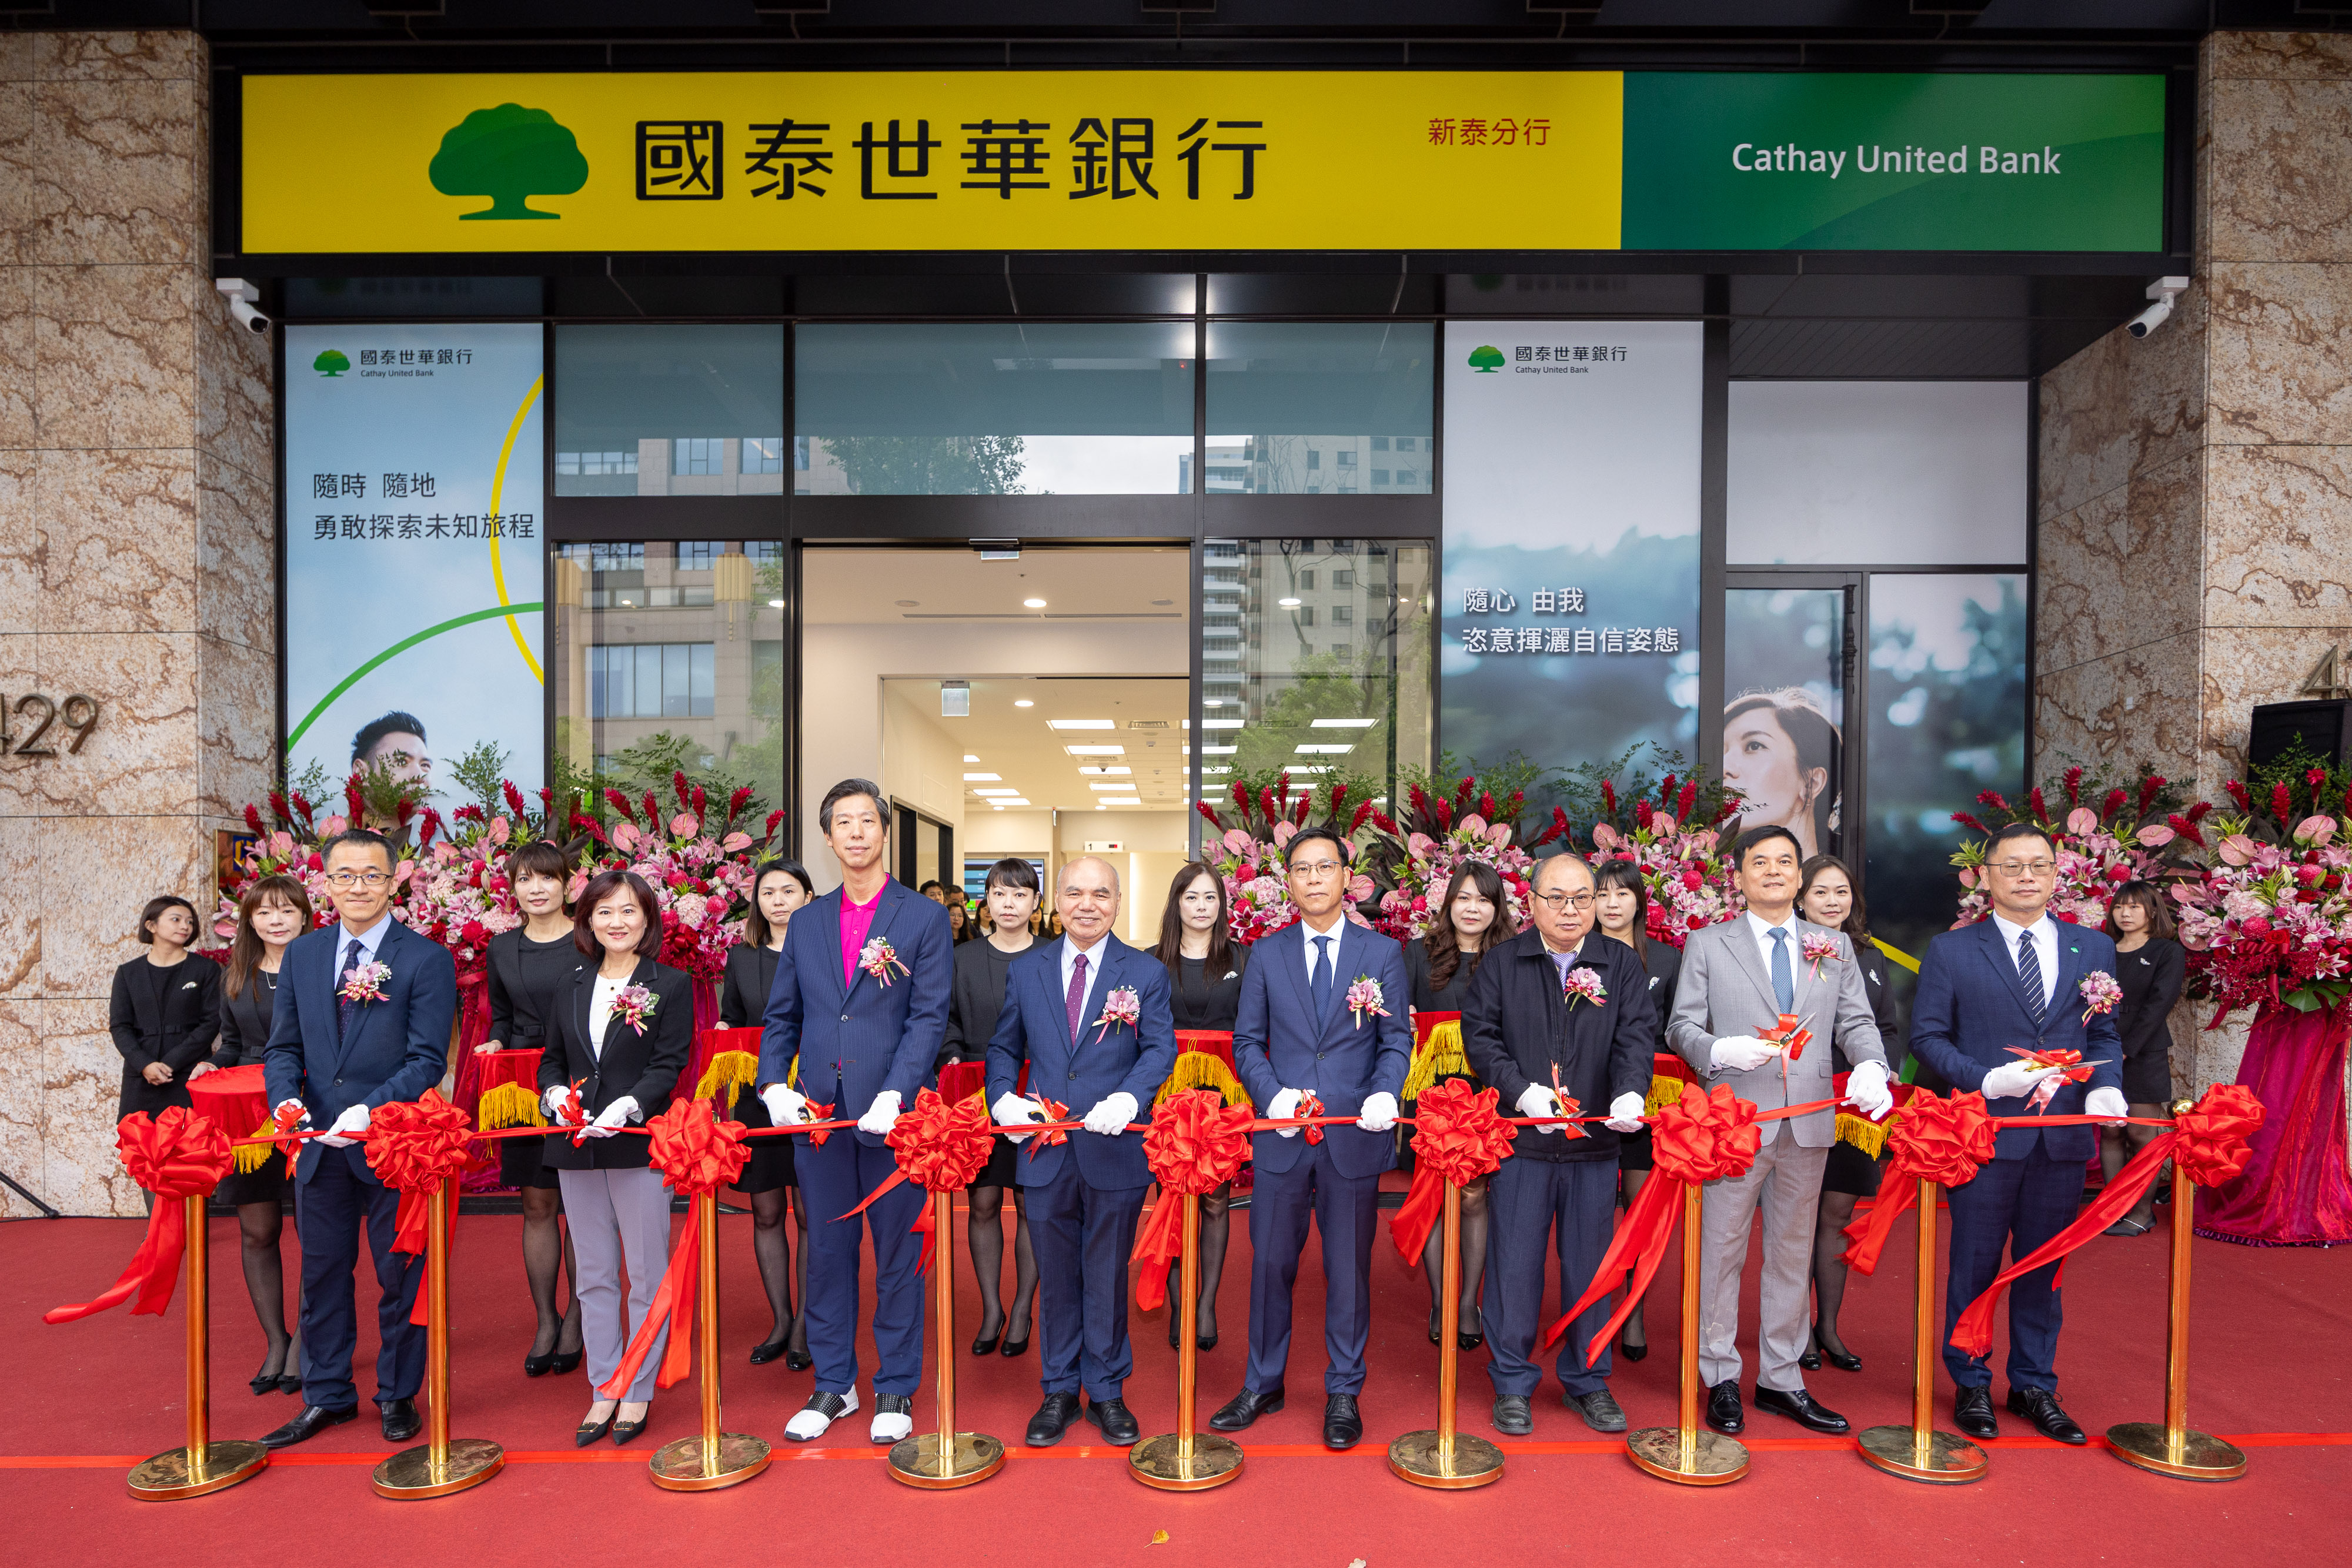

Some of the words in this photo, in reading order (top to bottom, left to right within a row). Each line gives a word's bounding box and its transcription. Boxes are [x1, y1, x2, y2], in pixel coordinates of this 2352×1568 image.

[1428, 118, 1551, 146] 新泰分行
[635, 118, 1267, 201] 國泰世華銀行
[1732, 143, 1846, 179] Cathay
[1856, 145, 1967, 173] United
[1979, 146, 2062, 174] Bank
[360, 349, 473, 365] 國泰世華銀行
[1515, 346, 1628, 362] 國泰世華銀行
[360, 369, 386, 378] Cathay
[1515, 366, 1541, 375] Cathay
[313, 473, 366, 499] 隨時
[383, 472, 437, 499] 隨地
[314, 513, 535, 540] 勇敢探索未知旅程
[1462, 587, 1516, 613] 隨心
[1532, 587, 1585, 613] 由我
[1462, 626, 1679, 654] 恣意揮灑自信姿態
[2300, 644, 2352, 700] 4
